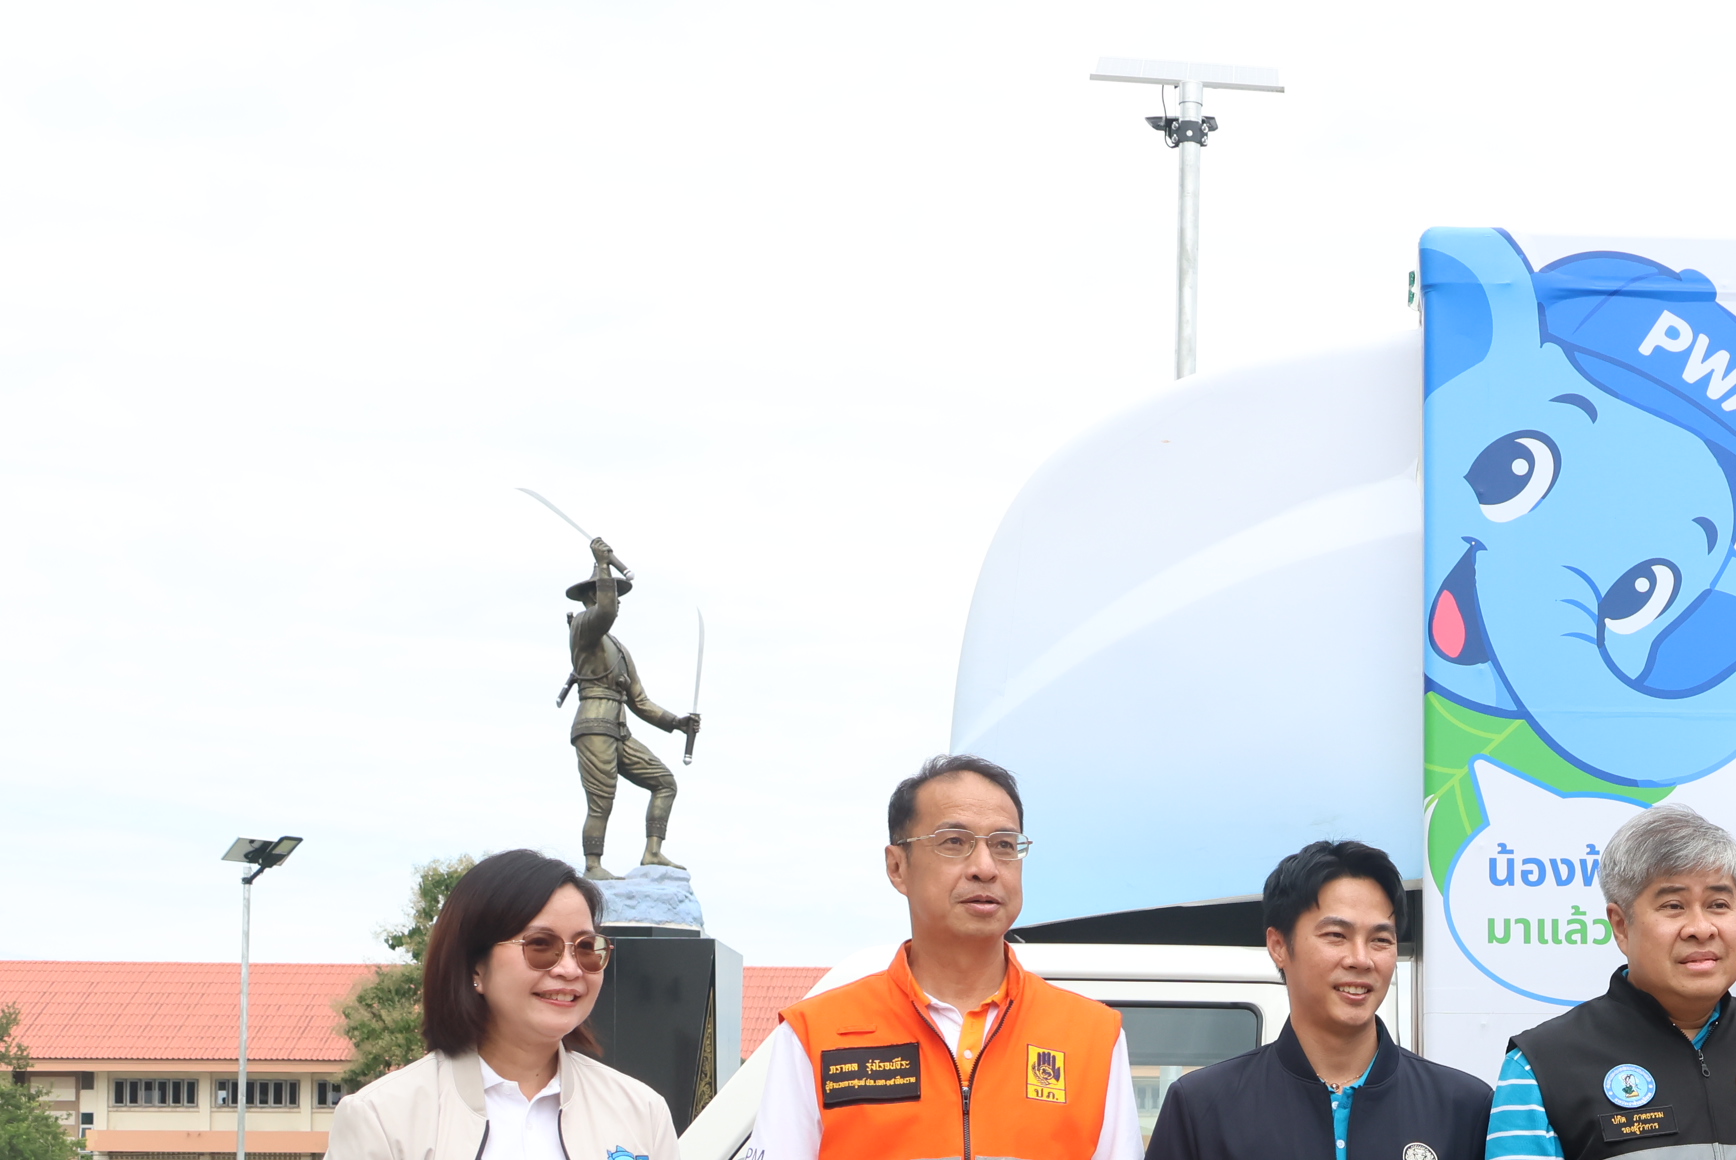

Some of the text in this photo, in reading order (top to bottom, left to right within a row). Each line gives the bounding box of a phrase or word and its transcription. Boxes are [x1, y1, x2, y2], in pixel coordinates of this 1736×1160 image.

[1486, 904, 1613, 946] มาแล้ว
[1621, 1122, 1659, 1134] รองผู้ว่าการ
